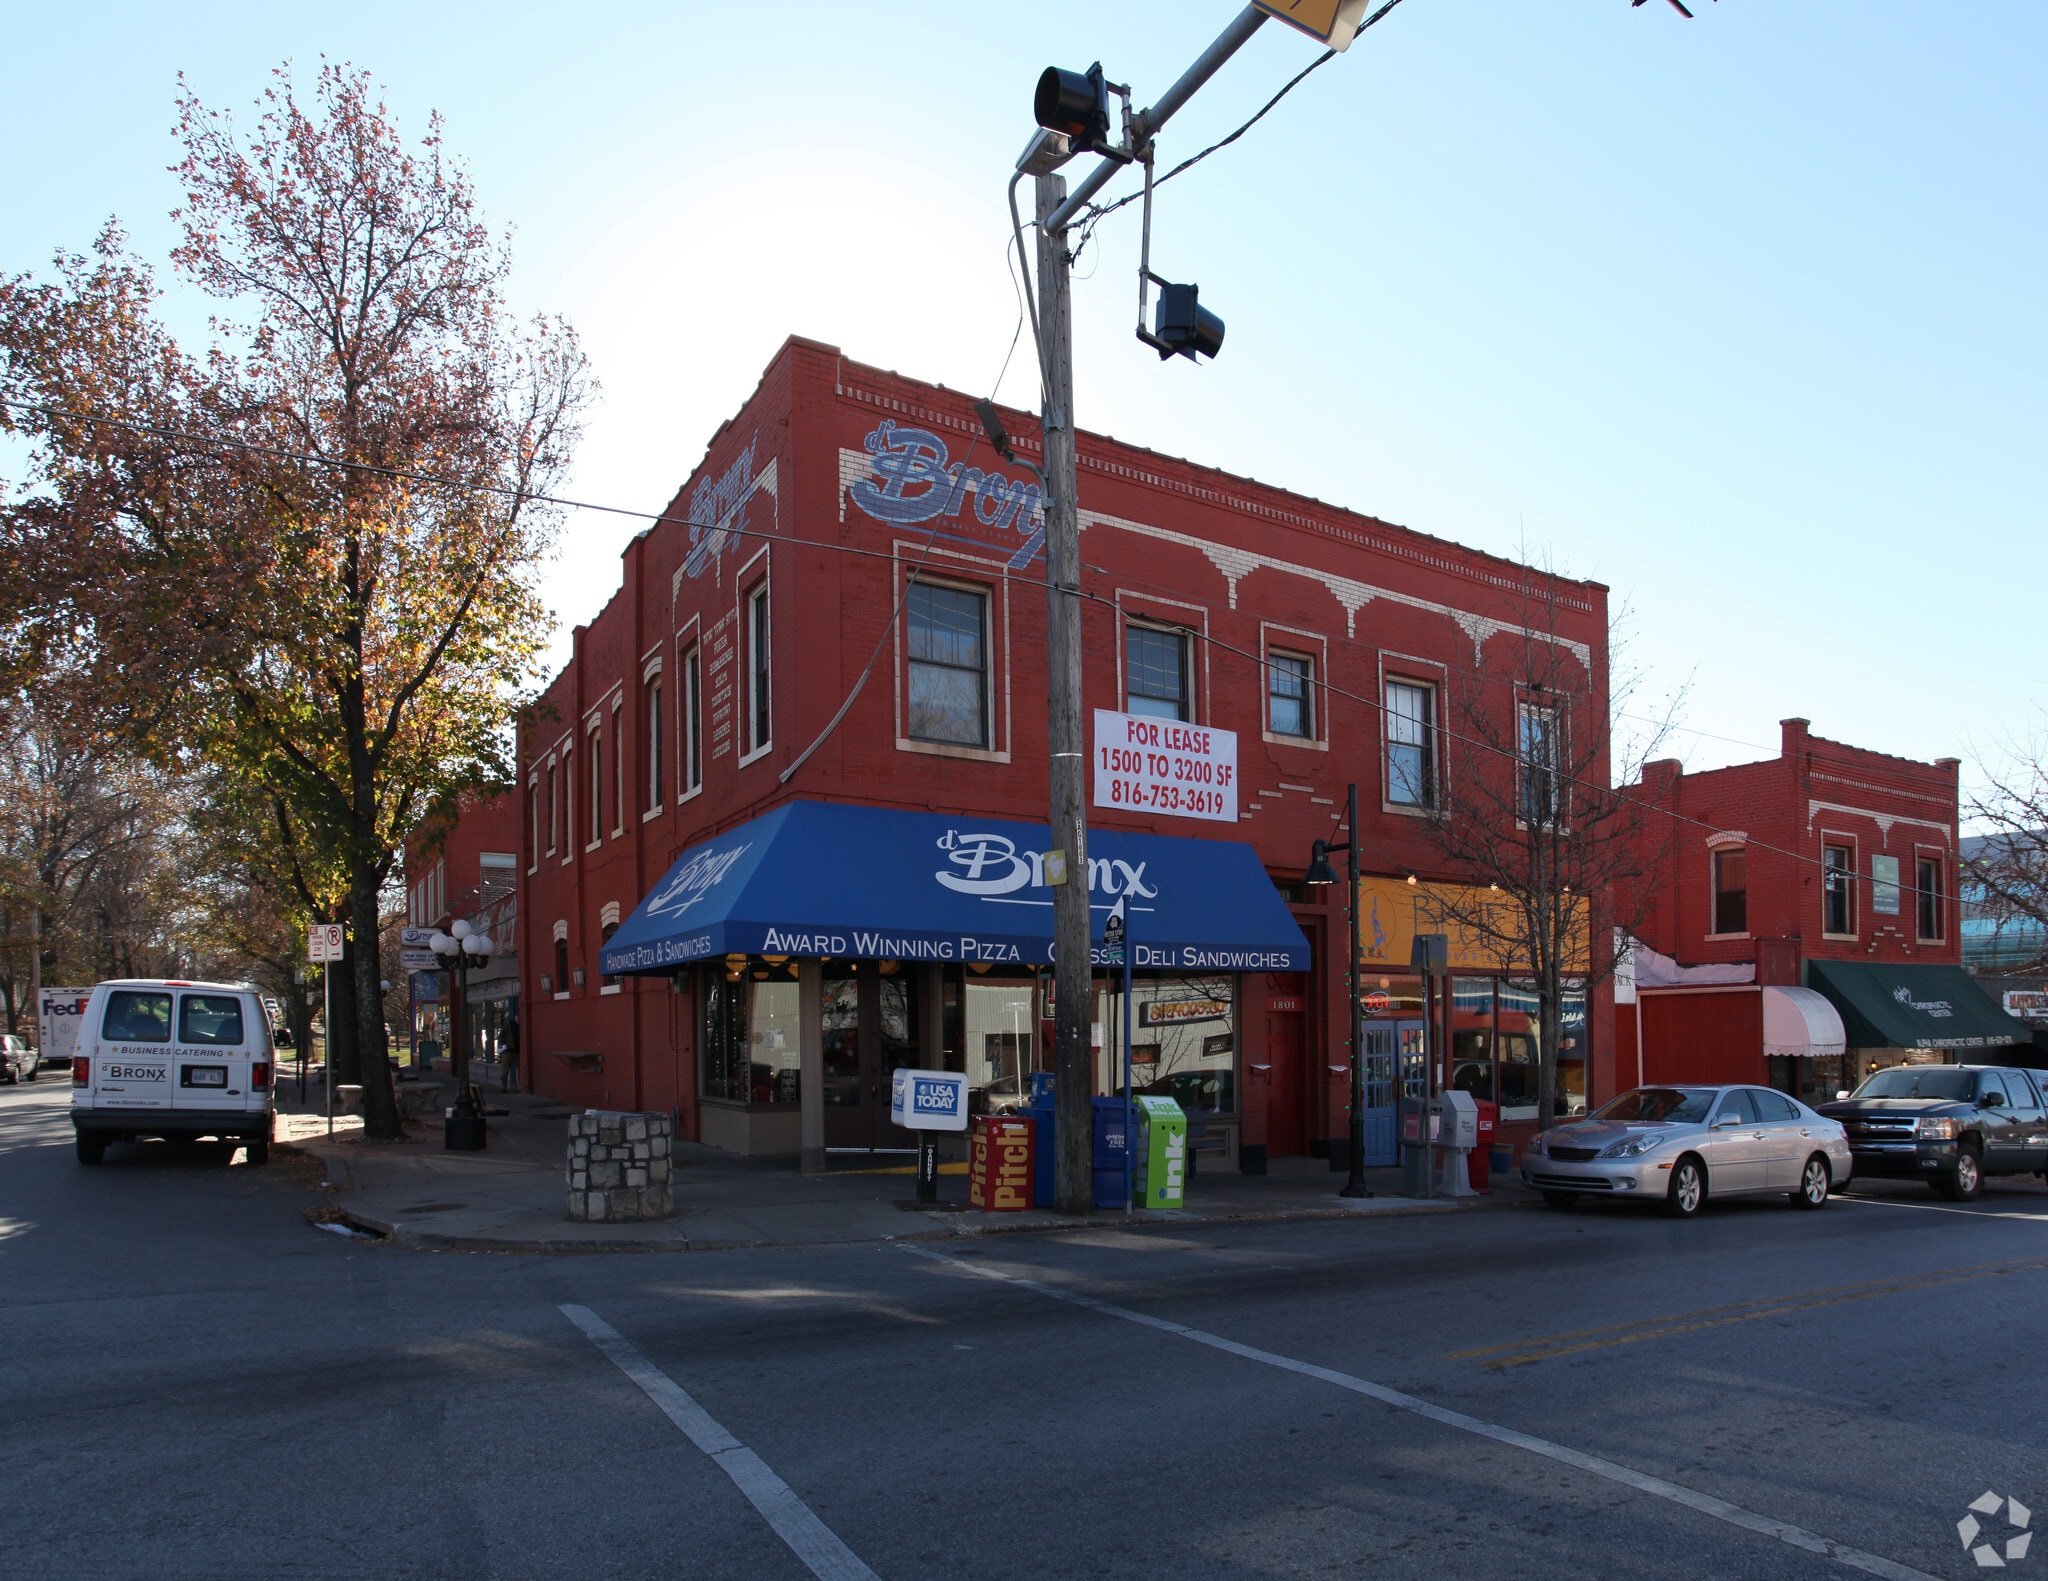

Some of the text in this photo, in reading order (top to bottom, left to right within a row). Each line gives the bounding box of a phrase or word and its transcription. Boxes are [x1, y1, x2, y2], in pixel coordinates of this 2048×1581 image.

[1127, 720, 1210, 755] FOR LEASE
[1102, 747, 1232, 786] 1500 TO 3200 SF
[1111, 779, 1224, 814] 816-753-3619
[606, 935, 711, 971] HANDMADE PIZZA & SANDWICHES
[762, 928, 846, 954] AWARD
[852, 932, 952, 958] WINNING
[960, 938, 1020, 960] PIZZA
[1136, 945, 1176, 966] DELI
[1184, 947, 1290, 968] SANDWICHES
[1273, 1000, 1295, 1009] 1801
[1363, 996, 1389, 1009] OPEN
[1928, 1010, 1953, 1018] CENTER
[121, 1046, 224, 1057] BUSINESS CATERING
[916, 1095, 956, 1109] TODAY
[930, 1084, 954, 1097] USA
[970, 1125, 988, 1206] Pitch
[994, 1127, 1028, 1208] Pitch
[1158, 1131, 1184, 1199] ink
